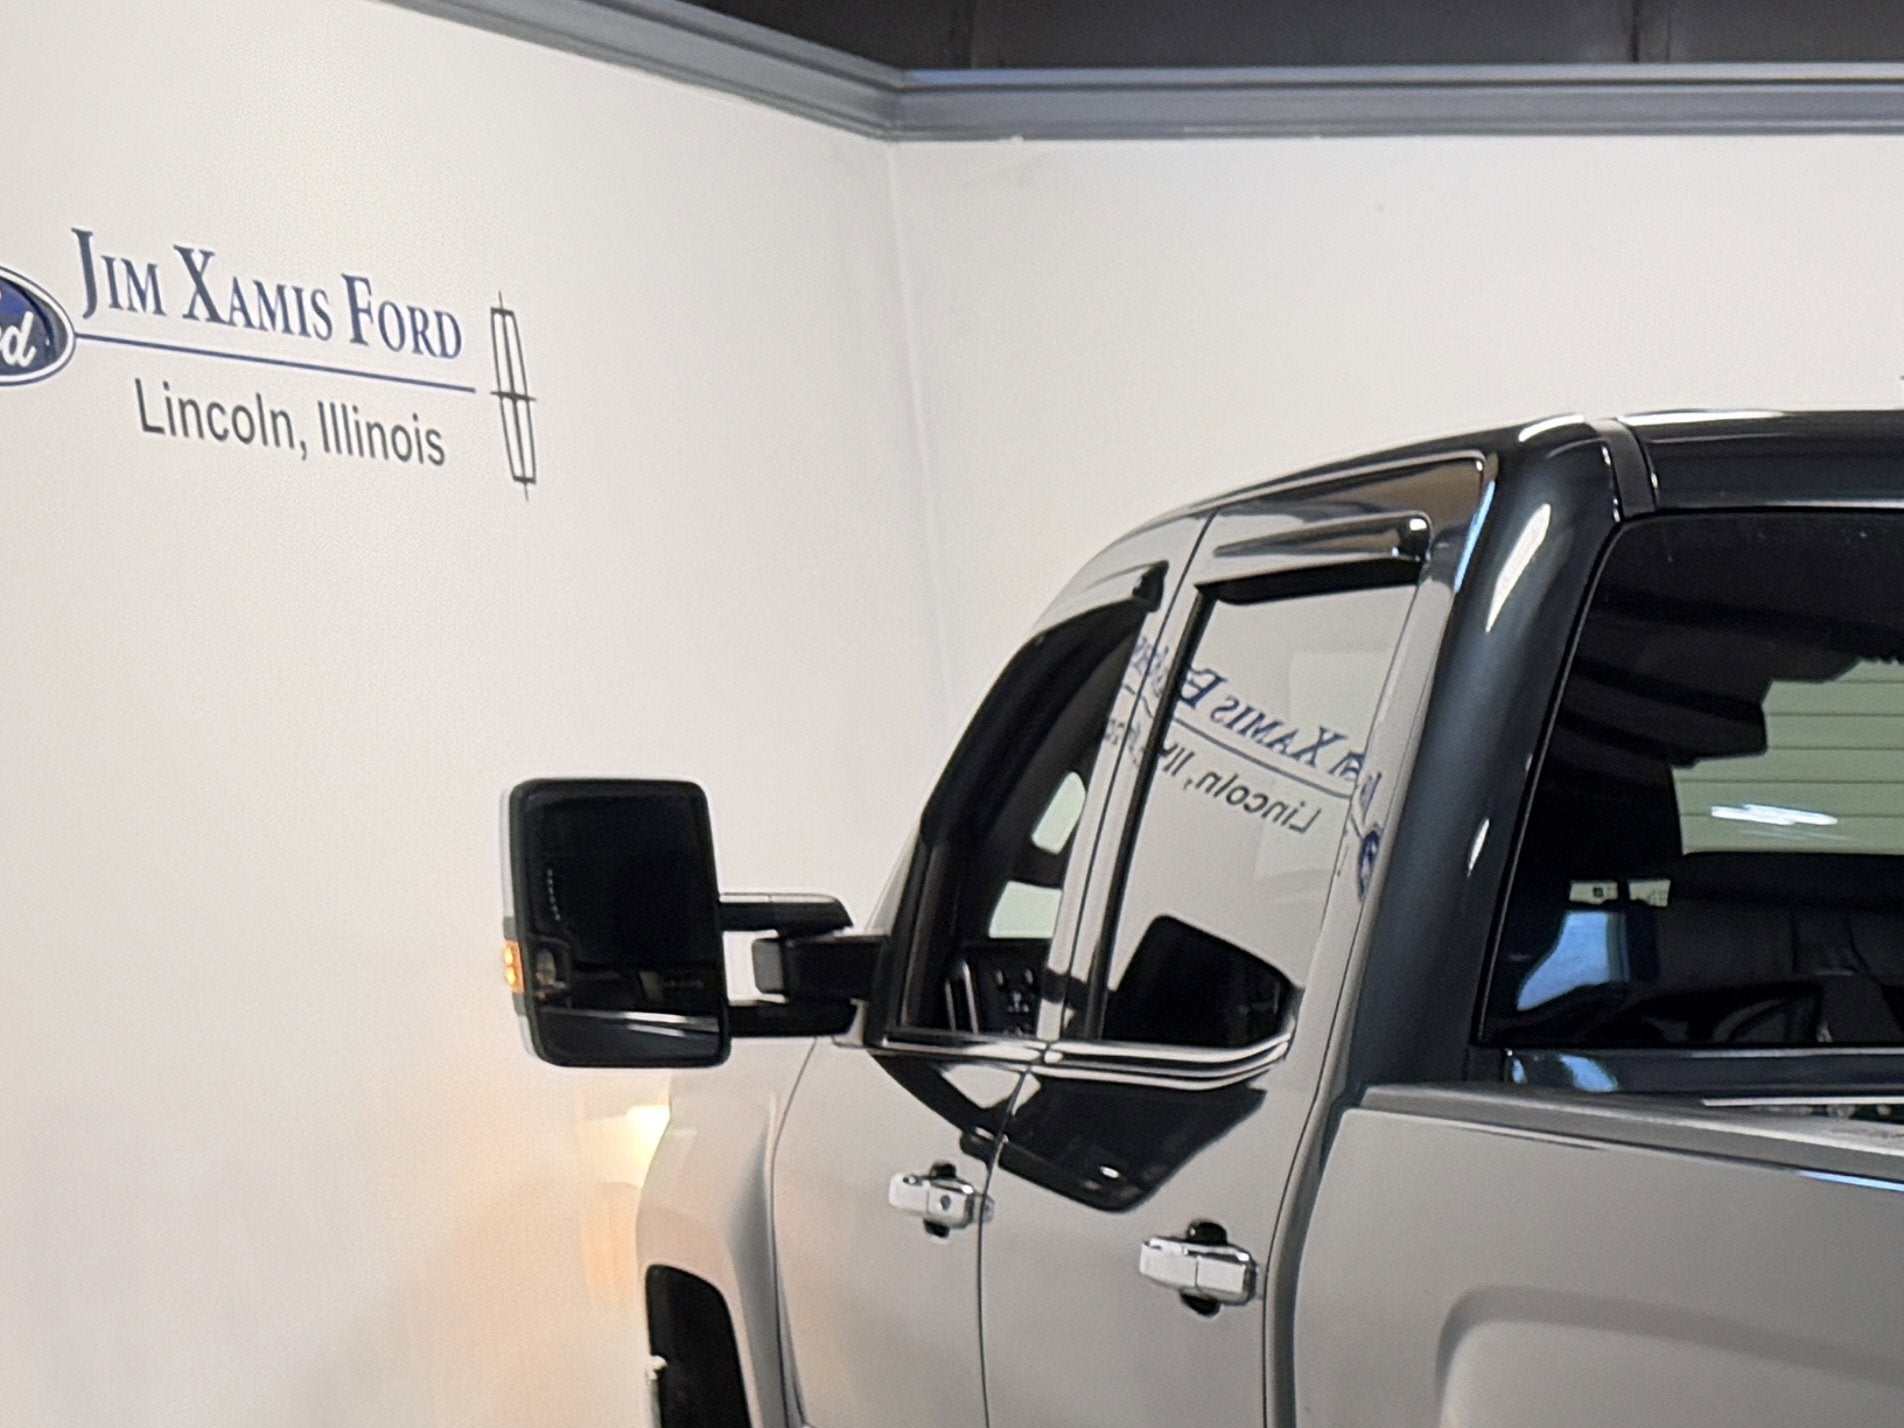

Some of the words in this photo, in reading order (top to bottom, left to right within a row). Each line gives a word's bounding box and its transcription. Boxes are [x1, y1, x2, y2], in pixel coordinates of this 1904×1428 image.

[71, 227, 167, 320] JIM
[173, 244, 334, 342] XAMIS
[341, 273, 463, 360] FORD
[135, 377, 308, 462] Lincoln,
[317, 399, 446, 468] Illinois
